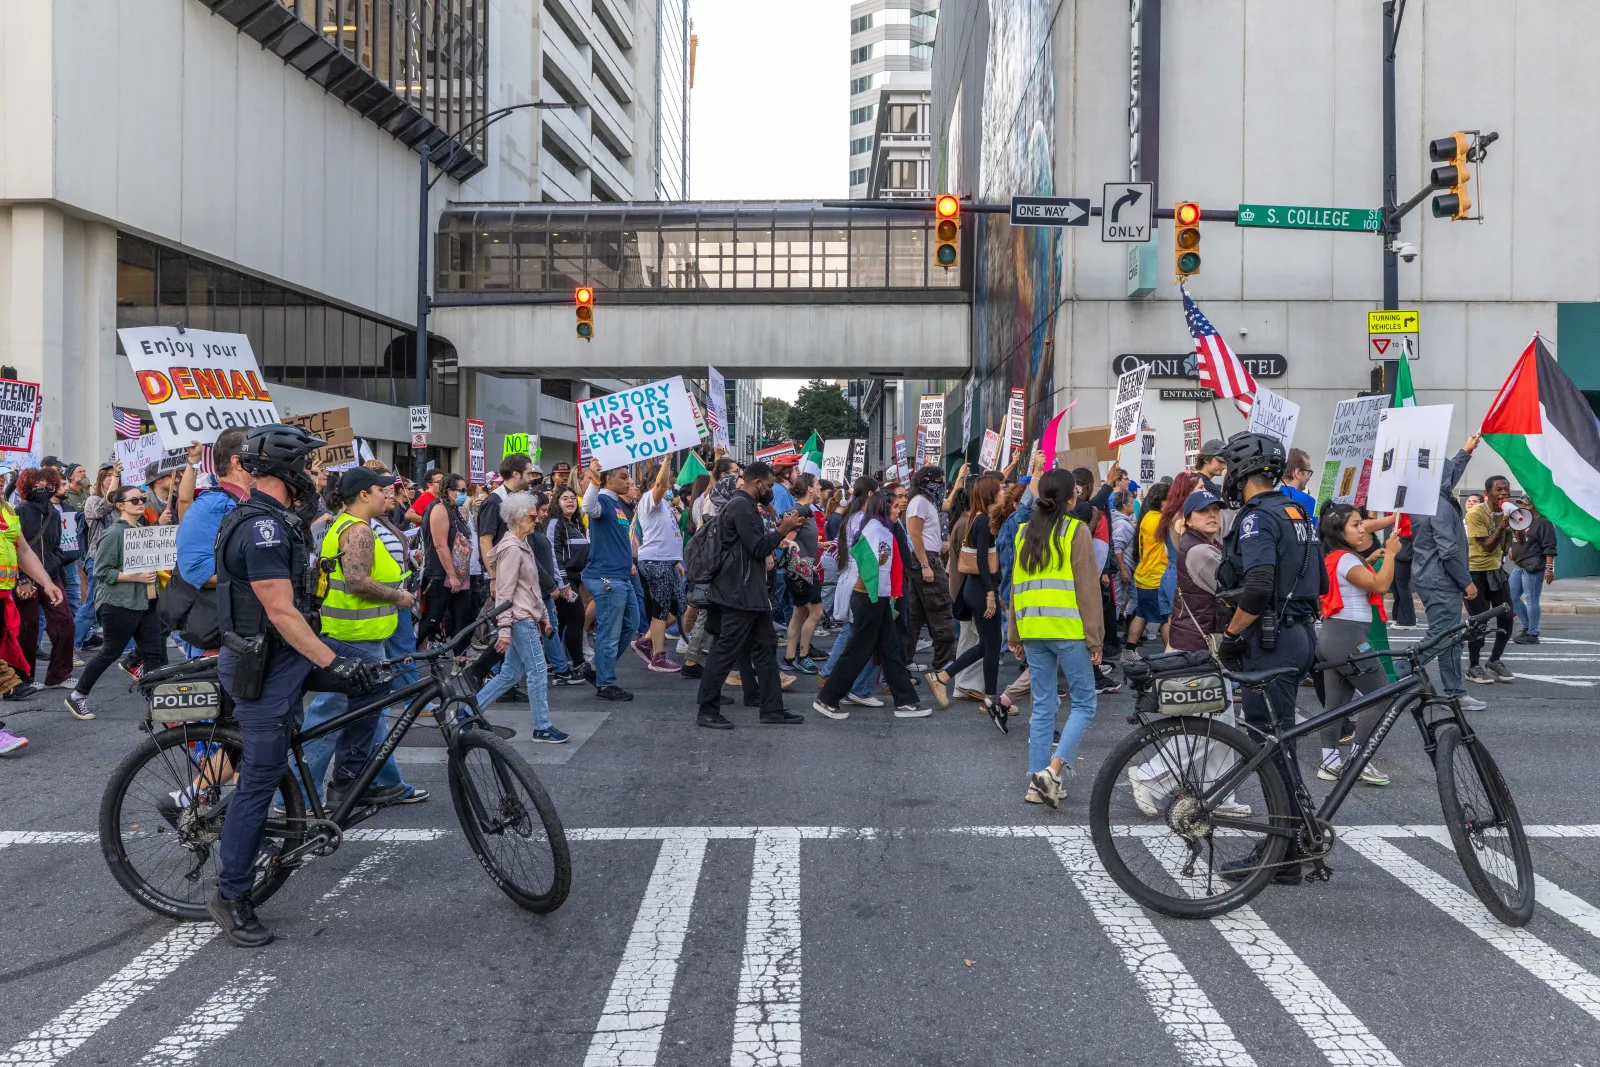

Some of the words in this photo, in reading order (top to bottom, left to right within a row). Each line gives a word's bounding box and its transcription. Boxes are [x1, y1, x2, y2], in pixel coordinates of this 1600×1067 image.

[1019, 205, 1041, 217] ONE
[1044, 206, 1067, 217] WAY
[1267, 208, 1280, 223] S.
[1287, 209, 1350, 226] COLLEGE
[1368, 210, 1378, 219] ST
[1108, 226, 1145, 238] ONLY
[1363, 219, 1378, 230] 100
[140, 337, 194, 358] Enjoy
[202, 343, 238, 358] your
[136, 366, 273, 405] DENIAL
[1119, 368, 1146, 394] DEFEND
[583, 383, 670, 418] HISTORY
[1162, 390, 1211, 398] ENTRANCE
[0, 399, 34, 414] OCRACY:
[1131, 400, 1141, 413] FOR
[1269, 394, 1284, 413] NO
[411, 415, 428, 423] WAY
[591, 408, 634, 432] HAS
[637, 399, 669, 420] ITS
[920, 409, 932, 418] JOBS
[932, 409, 943, 417] AND
[1256, 407, 1288, 434] HUMAN
[17, 416, 32, 428] FOR
[1332, 420, 1352, 435] OUR
[588, 424, 635, 449] EYES
[642, 415, 673, 435] ON
[927, 430, 941, 438] MASS
[123, 439, 137, 455] NO
[141, 433, 156, 448] ONE
[506, 436, 522, 453] NO
[625, 432, 677, 459] YOU!
[1141, 435, 1155, 455] STOP
[1185, 439, 1200, 451] POWER
[136, 450, 144, 460] IS
[1327, 447, 1347, 458] AWAY
[1345, 446, 1361, 459] FROM
[1141, 469, 1154, 480] OUR
[125, 529, 154, 540] HANDS
[159, 526, 176, 537] OFF
[125, 541, 141, 551] OUR
[125, 555, 160, 567] ABOLISH
[164, 552, 177, 563] ICE
[153, 693, 218, 708] POLICE
[1161, 687, 1222, 703] POLICE
